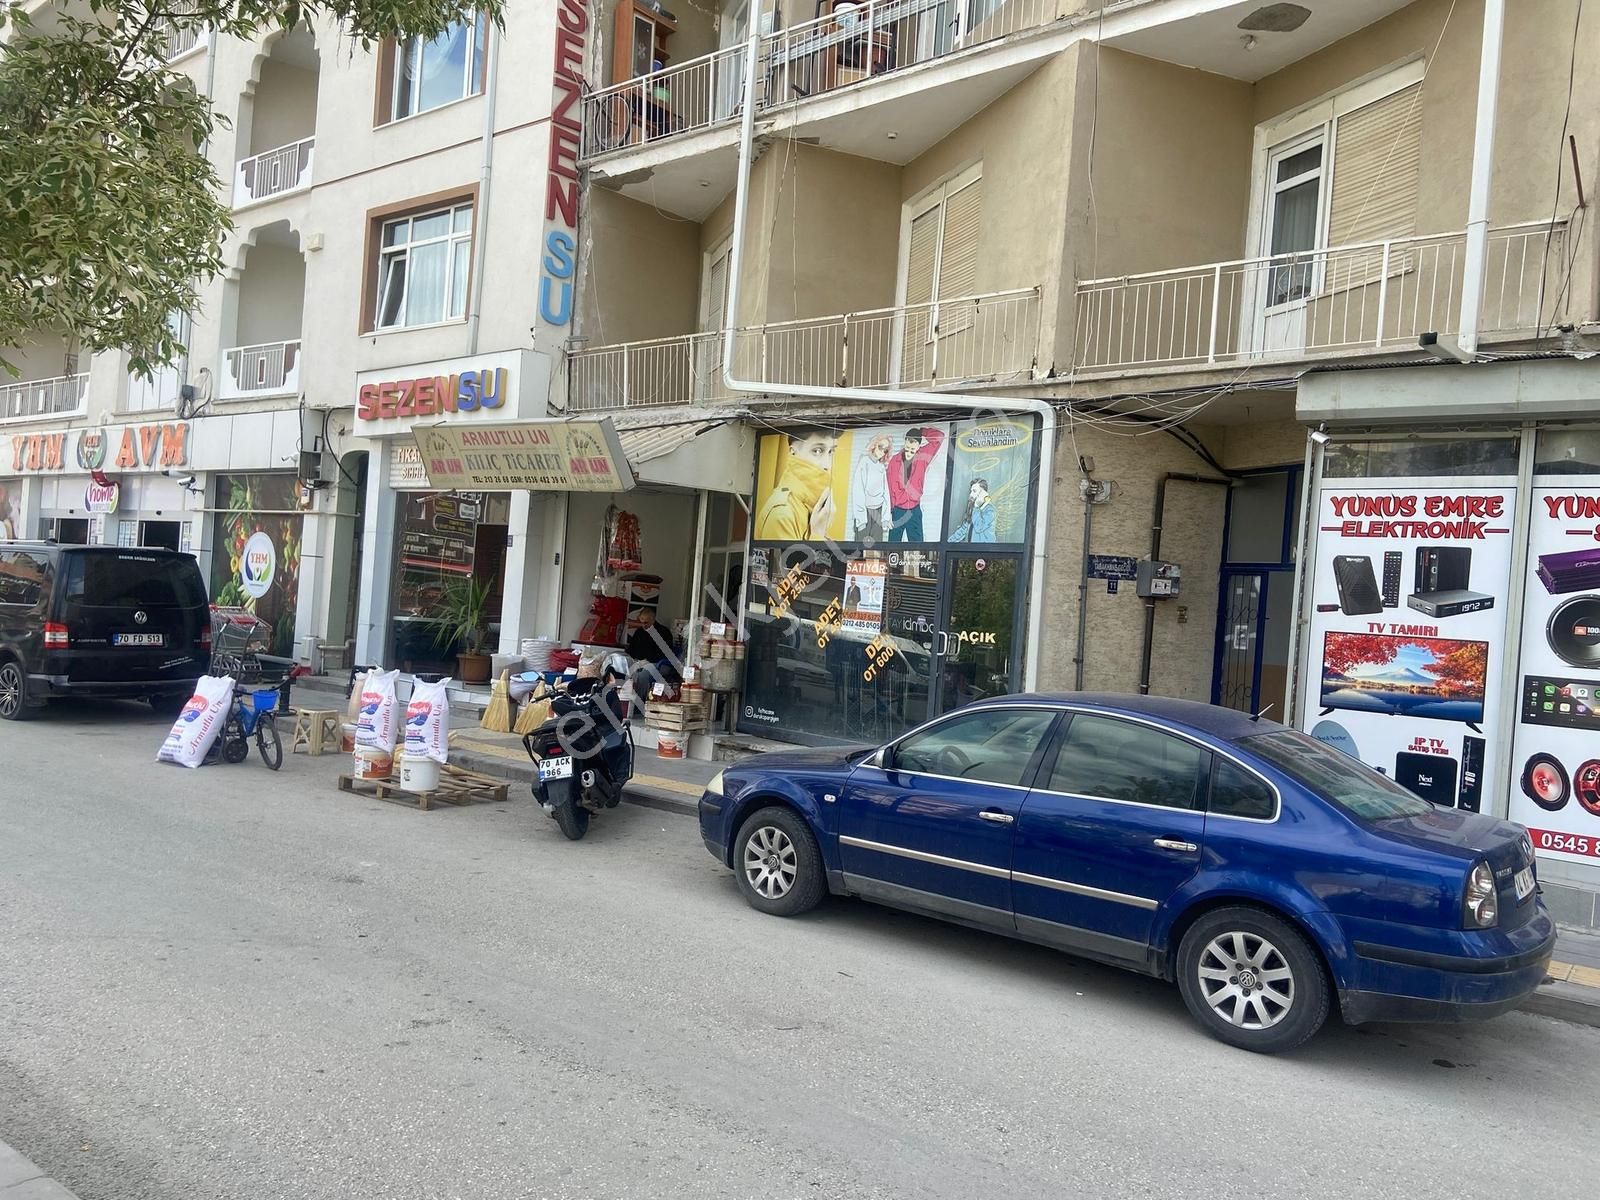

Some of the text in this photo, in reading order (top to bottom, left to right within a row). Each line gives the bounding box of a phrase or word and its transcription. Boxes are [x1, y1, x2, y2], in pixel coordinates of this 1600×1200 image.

[462, 430, 526, 447] ARMUTLU
[528, 429, 551, 445] UN
[12, 423, 190, 471] YHM AVM
[431, 459, 464, 474] AR UN
[570, 456, 610, 474] AR UN
[89, 485, 114, 502] home
[1330, 493, 1504, 519] YUNUS EMRE
[1341, 518, 1488, 540] ELEKTRONİK
[250, 552, 268, 564] YHM
[1367, 622, 1386, 634] TV
[119, 635, 129, 643] 70
[133, 635, 143, 643] FD
[960, 630, 996, 645] AÇIK
[1414, 736, 1445, 748] IP TV
[540, 757, 570, 769] 70 ACK
[546, 768, 561, 777] 966
[1541, 833, 1588, 852] 0545
